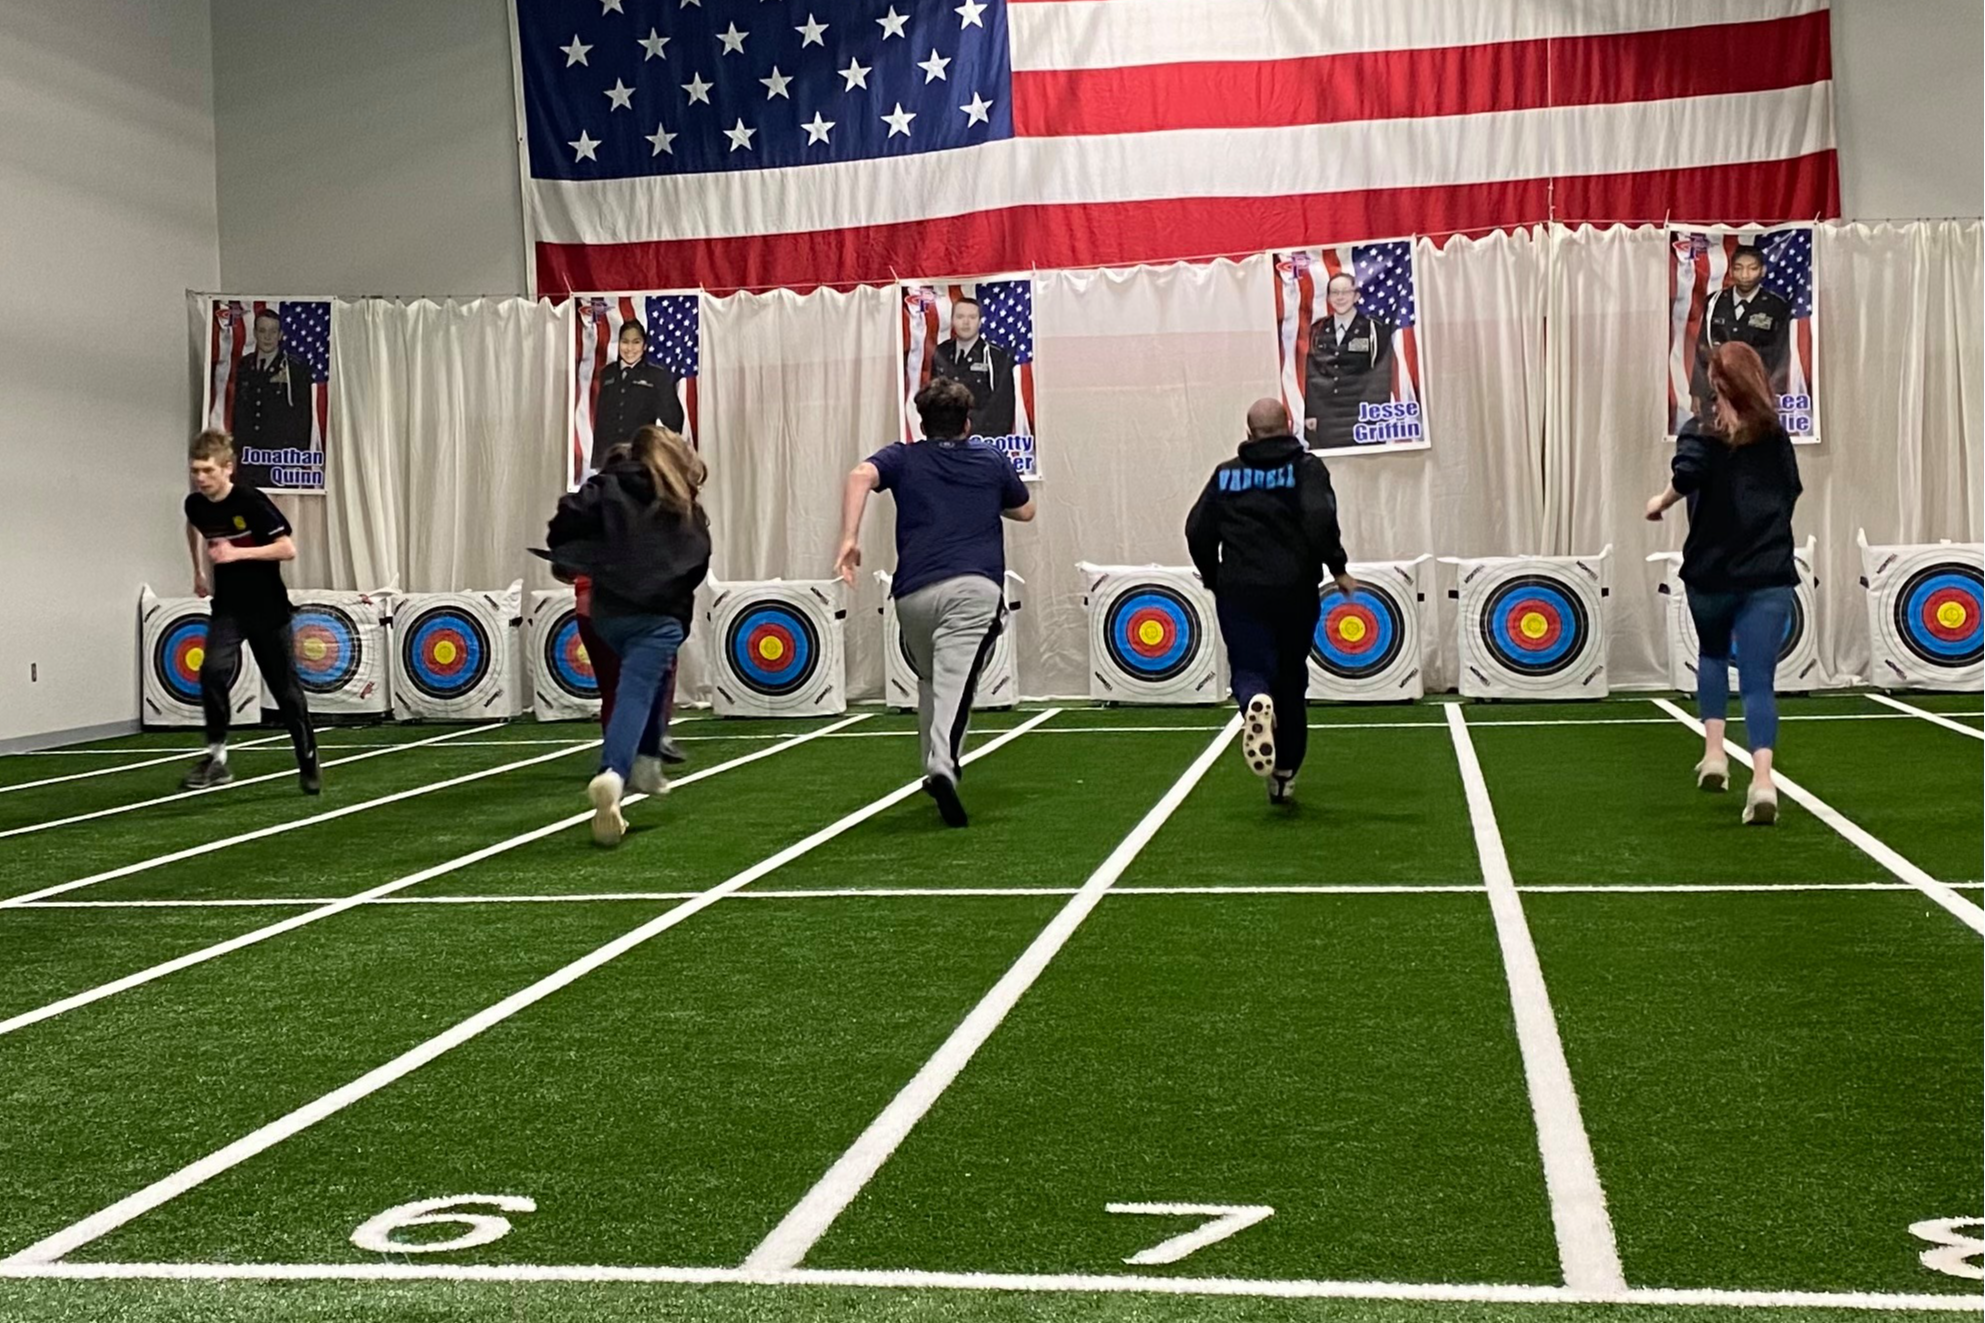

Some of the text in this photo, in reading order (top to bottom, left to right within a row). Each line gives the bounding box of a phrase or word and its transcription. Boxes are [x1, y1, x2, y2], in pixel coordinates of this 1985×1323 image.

[1359, 402, 1419, 421] Jesse
[1354, 421, 1421, 443] Griffin
[242, 447, 323, 465] Jonathan
[271, 467, 323, 486] Quinn
[350, 1193, 537, 1253] 6
[1105, 1202, 1275, 1265] 7
